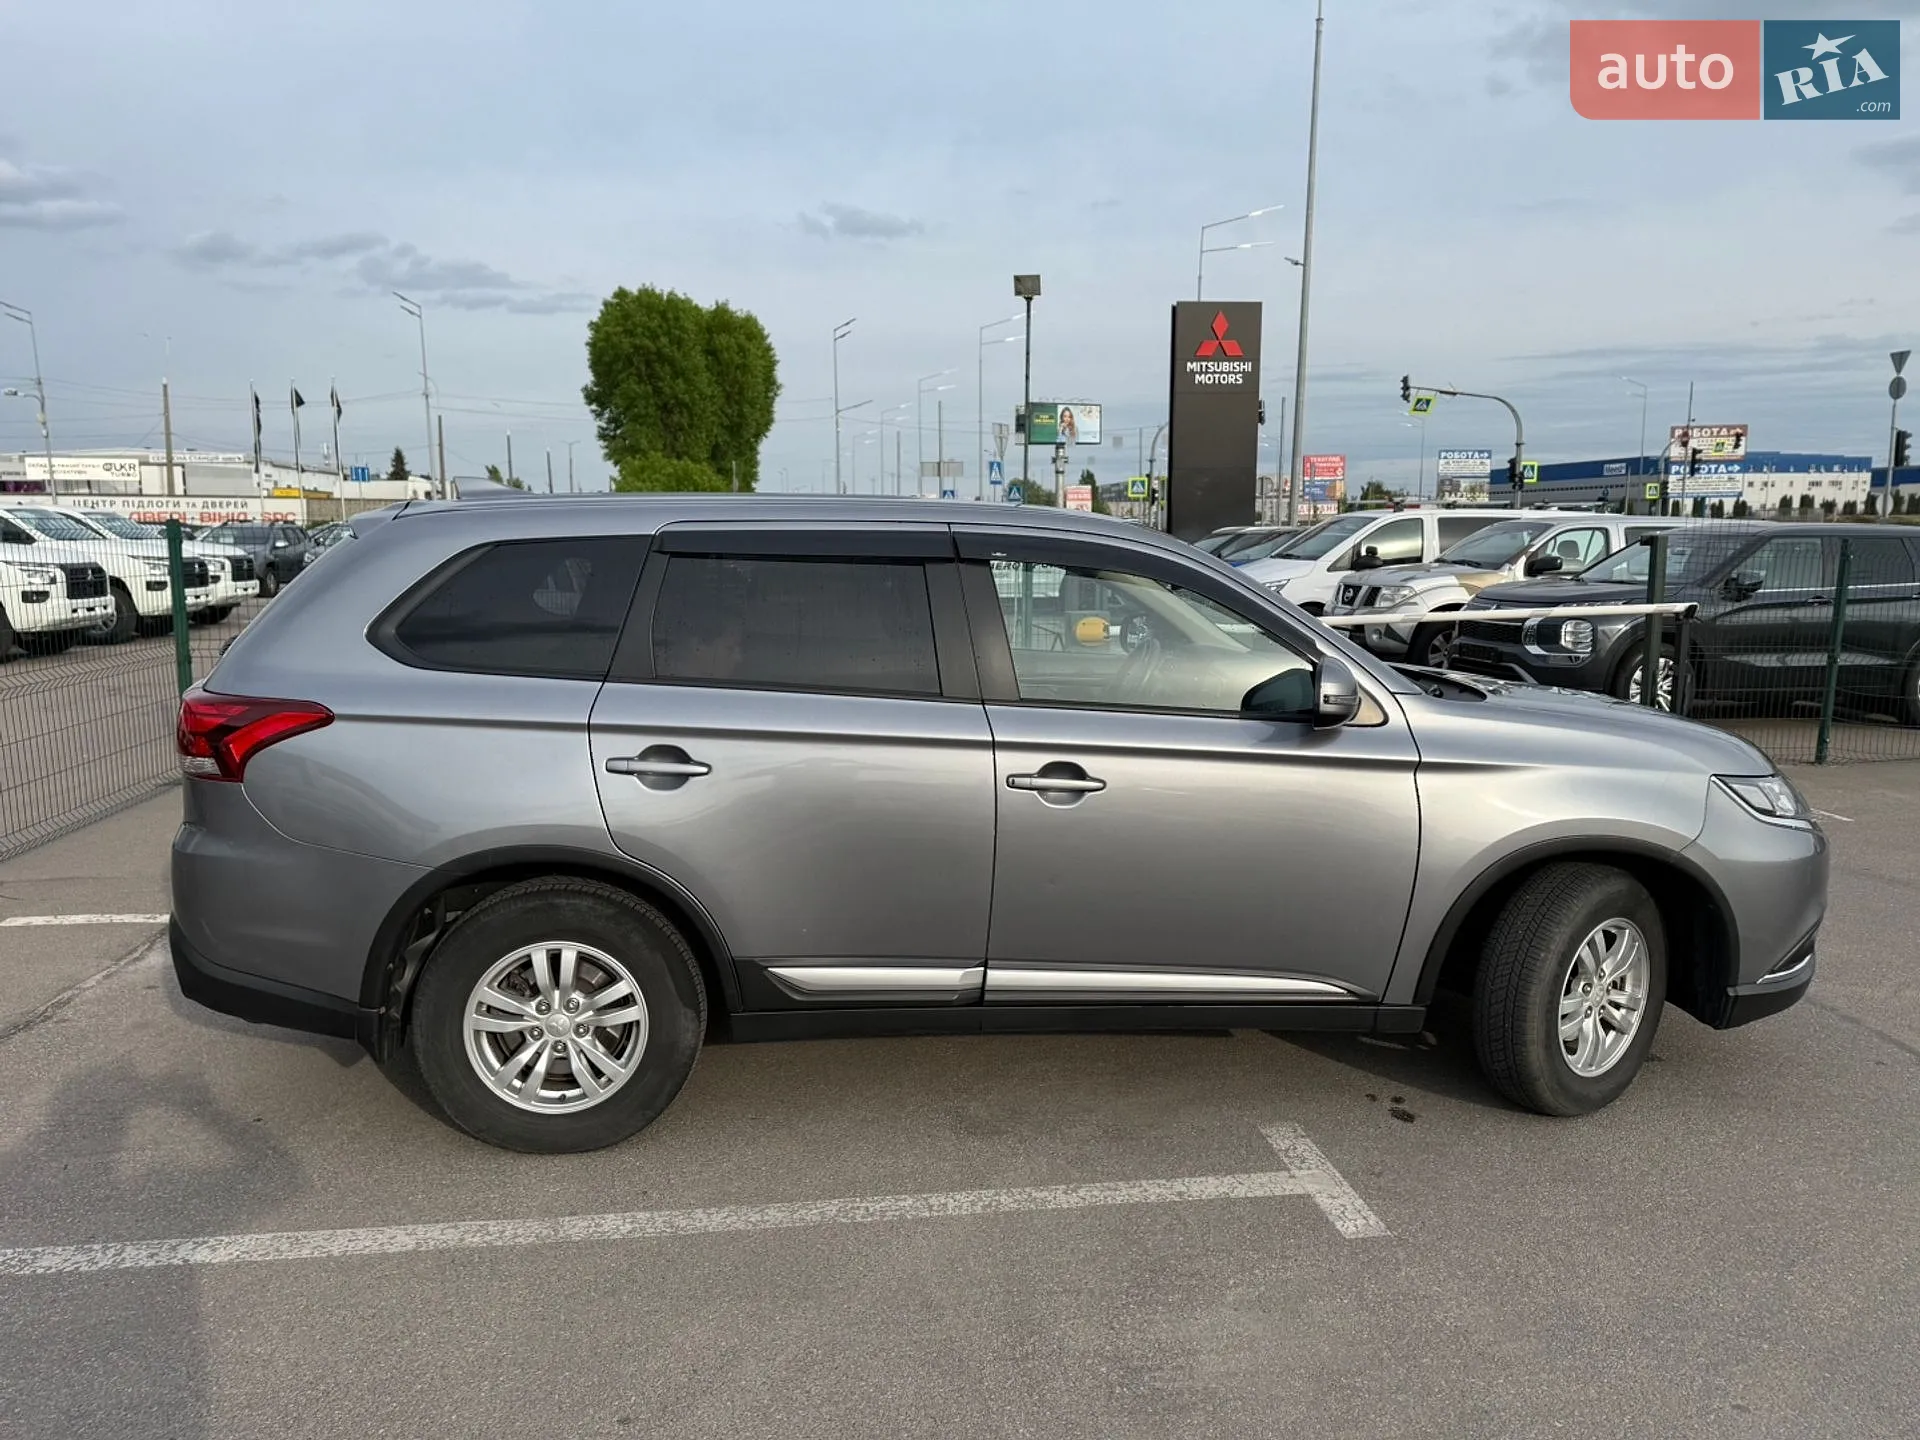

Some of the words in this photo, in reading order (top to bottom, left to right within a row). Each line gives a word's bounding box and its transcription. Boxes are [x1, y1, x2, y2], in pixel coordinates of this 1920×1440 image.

[1186, 361, 1252, 372] MITSUBISHI
[1194, 373, 1243, 384] MOTORS
[1440, 451, 1480, 459] РОБОТА
[1671, 464, 1727, 475] РООТА
[72, 499, 117, 509] ЦЕНТР
[122, 499, 181, 509] ПІДЛОГИ
[202, 499, 249, 509] ДВЕРЕЙ
